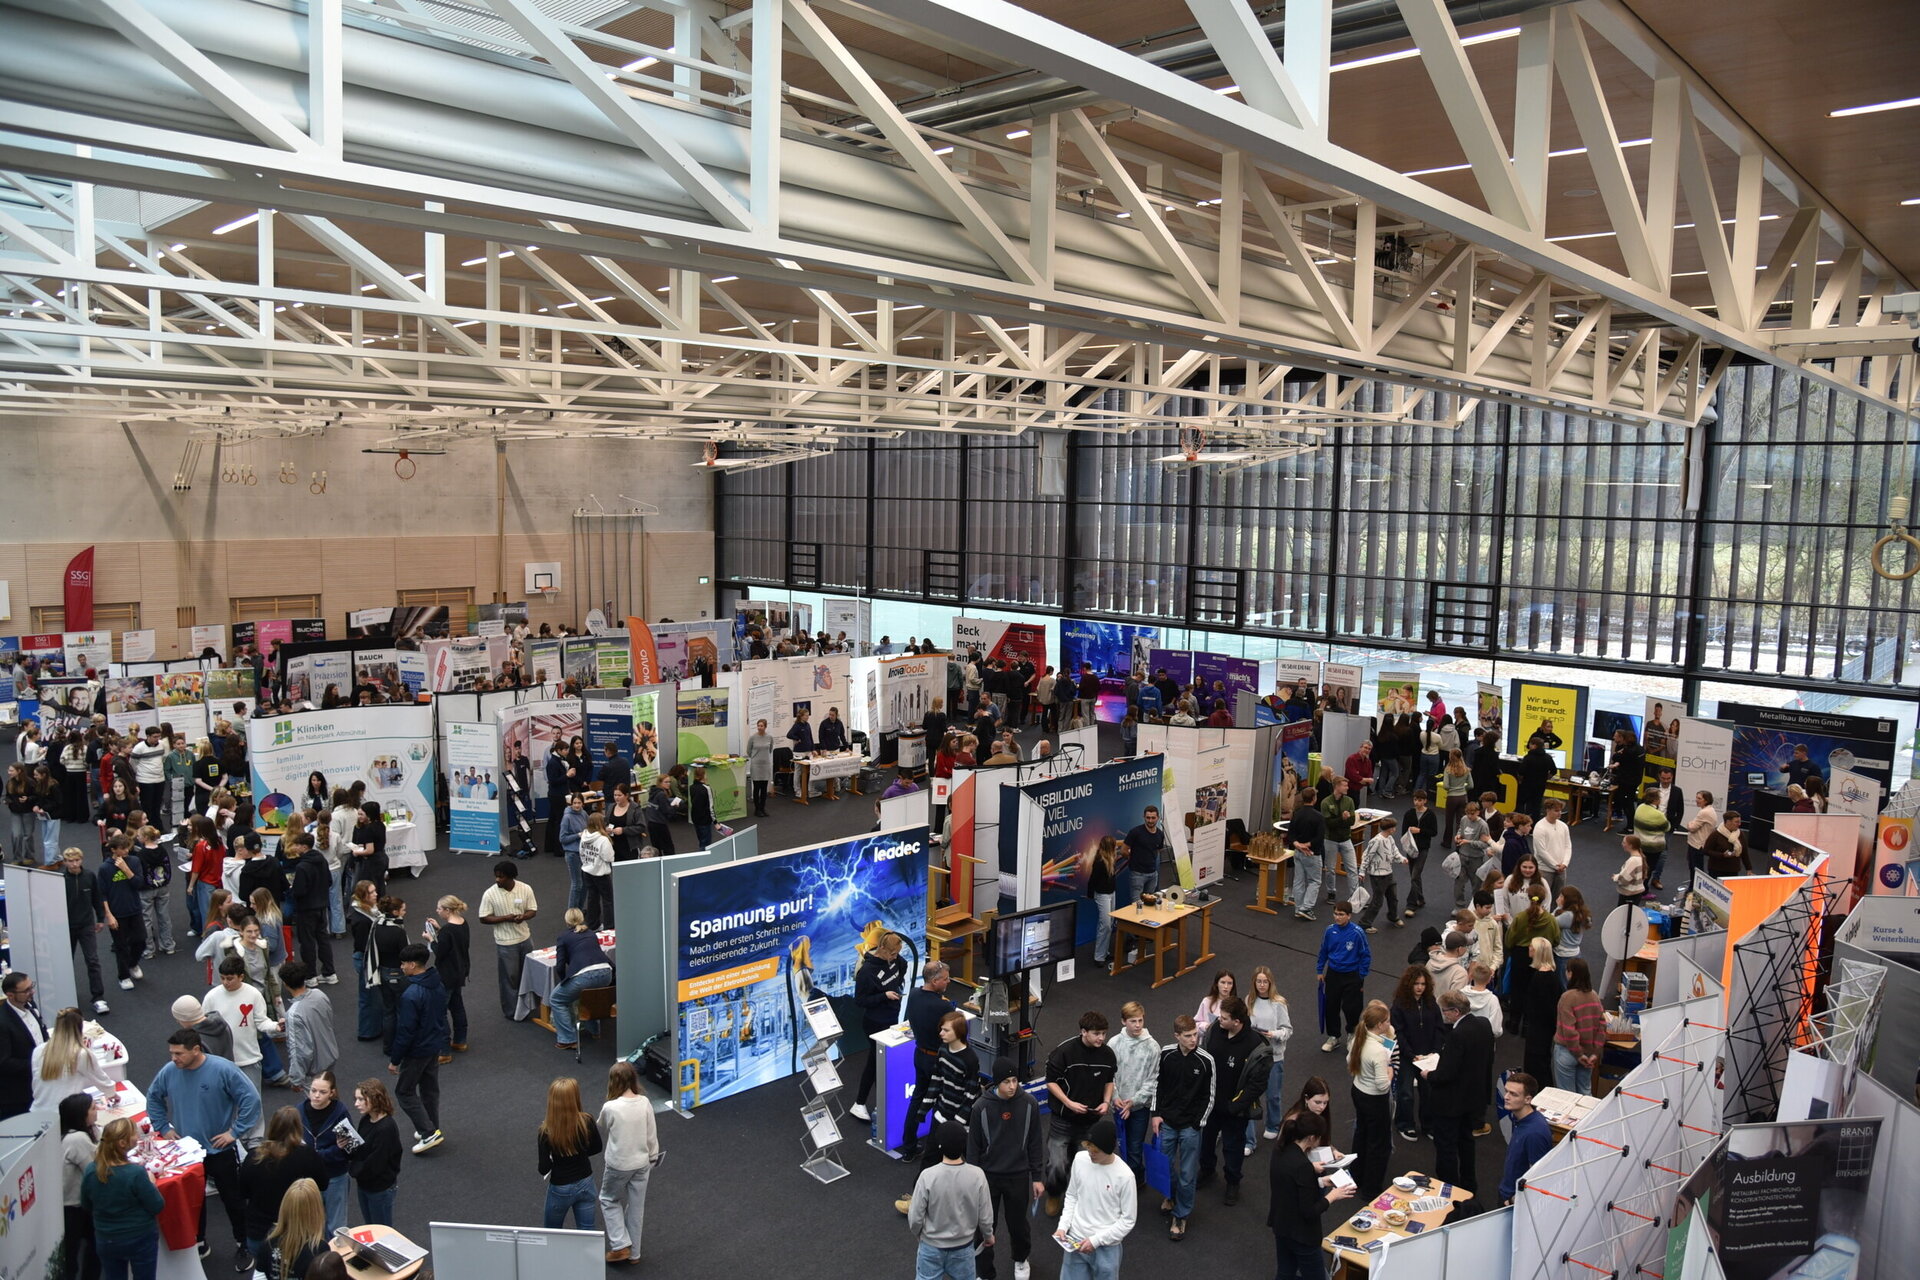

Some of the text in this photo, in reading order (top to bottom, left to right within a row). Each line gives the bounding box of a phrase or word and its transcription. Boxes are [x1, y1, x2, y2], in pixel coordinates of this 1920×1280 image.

[71, 571, 88, 580] SSG
[956, 624, 980, 636] Beck
[314, 670, 348, 679] Präzision
[888, 664, 925, 678] InovaTools
[1760, 712, 1845, 727] Metallbau Böhm GmbH
[297, 724, 334, 734] Kliniken
[306, 732, 334, 740] Naturpark
[276, 754, 304, 764] familiär
[281, 760, 322, 772] transparent
[1681, 756, 1726, 771] BÖHM
[285, 764, 360, 781] digital innovativ
[1119, 767, 1158, 784] KLASING
[1118, 778, 1158, 792] SPEZIALKABEL
[1048, 806, 1068, 822] VIEL
[1042, 817, 1083, 839] ANNUNG
[386, 844, 406, 852] niken
[874, 841, 921, 862] leadec
[690, 894, 813, 939] Spannung pur!
[690, 920, 806, 955] Mach den ersten Schritt in eine
[1872, 935, 1920, 944] Weiterbildu
[690, 938, 780, 967] elektrisierende Zukunft.
[689, 979, 715, 988] Entdecke
[726, 971, 740, 980] einer
[741, 963, 771, 975] Ausbildung
[700, 985, 713, 994] Welt
[713, 982, 723, 991] der
[1733, 1169, 1796, 1184] Ausbildung
[1761, 1186, 1801, 1194] FACHRICHTUNG
[1730, 1194, 1796, 1203] KONSTRUKTIONSTECHNIK
